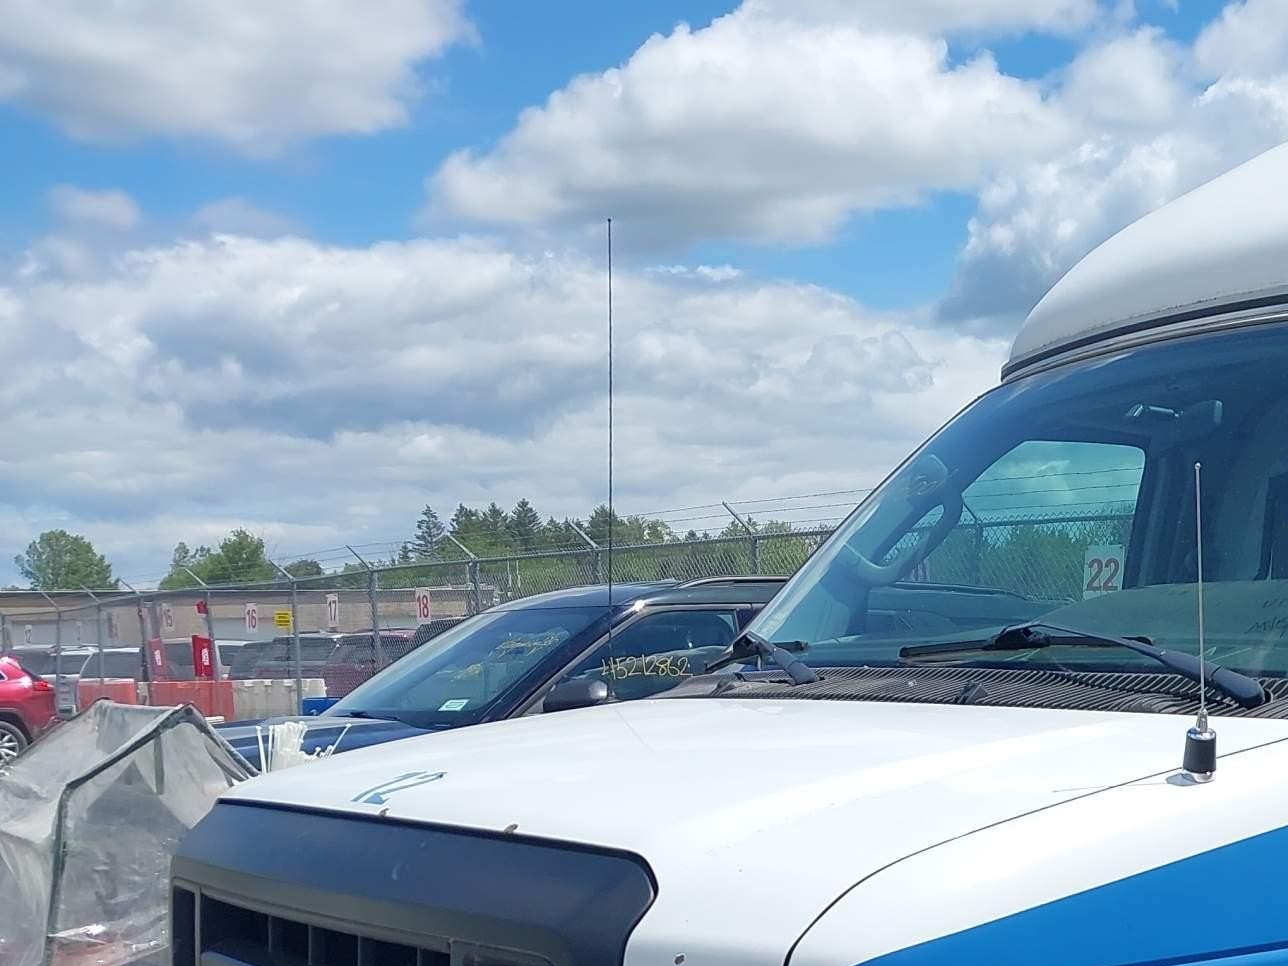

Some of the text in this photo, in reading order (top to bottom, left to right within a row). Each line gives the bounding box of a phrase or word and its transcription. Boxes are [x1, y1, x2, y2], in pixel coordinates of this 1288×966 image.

[1086, 557, 1120, 592] 22
[246, 608, 257, 629] 16
[327, 599, 338, 622] 17
[416, 594, 430, 619] 18
